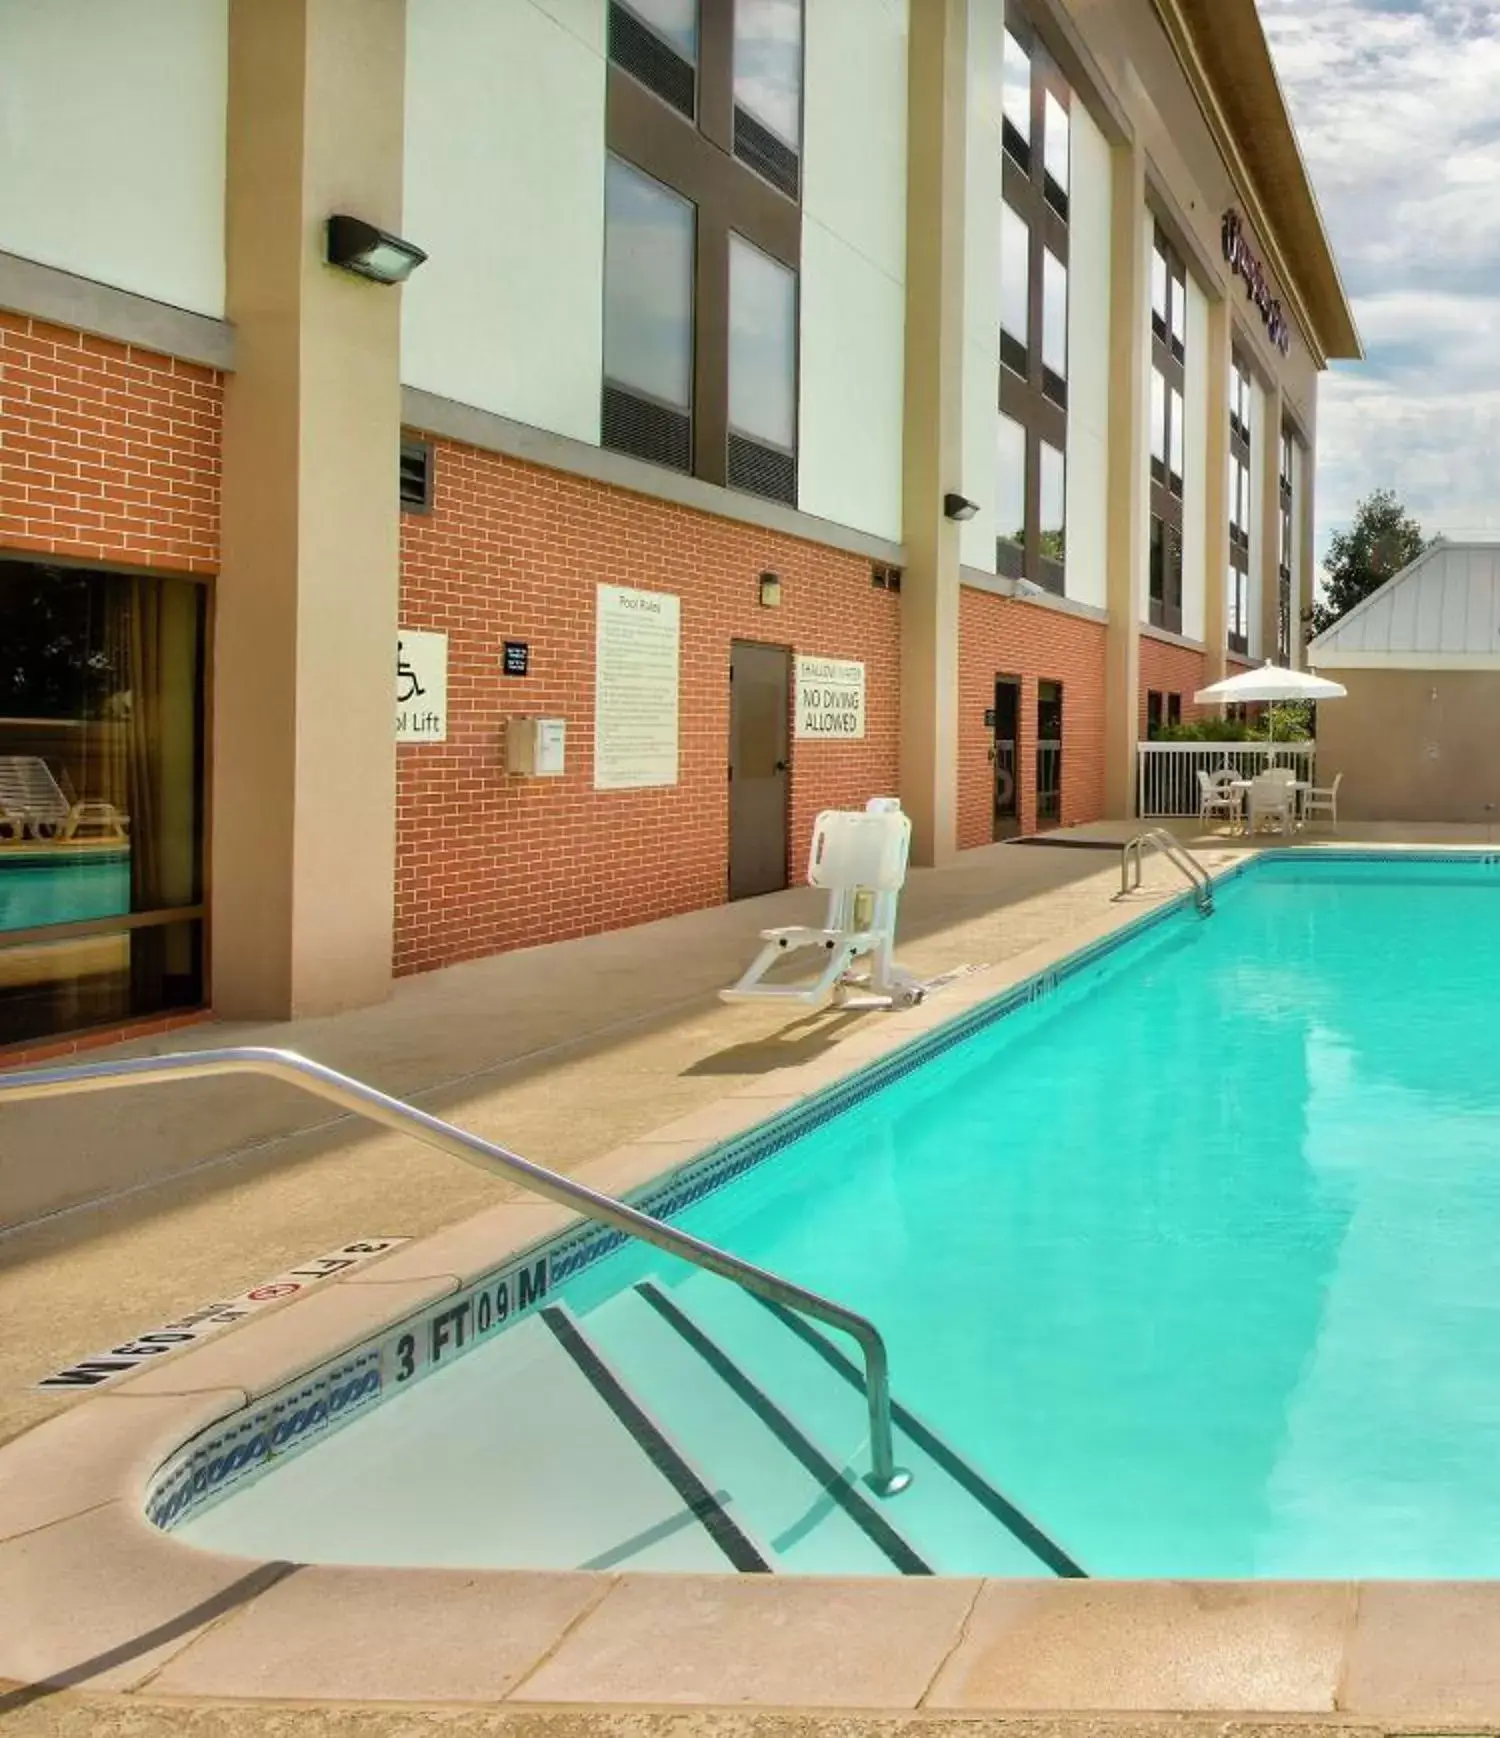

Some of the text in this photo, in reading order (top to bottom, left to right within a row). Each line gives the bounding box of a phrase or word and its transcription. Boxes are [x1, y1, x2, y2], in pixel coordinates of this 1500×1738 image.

[619, 595, 639, 610] Pool
[803, 688, 860, 710] NO DIVING
[413, 711, 440, 732] Lift
[804, 712, 857, 733] ALLOWED
[291, 1258, 358, 1280] FT
[395, 1333, 416, 1382] 3
[431, 1302, 471, 1362] FT
[518, 1258, 548, 1312] M
[38, 1360, 141, 1386] M
